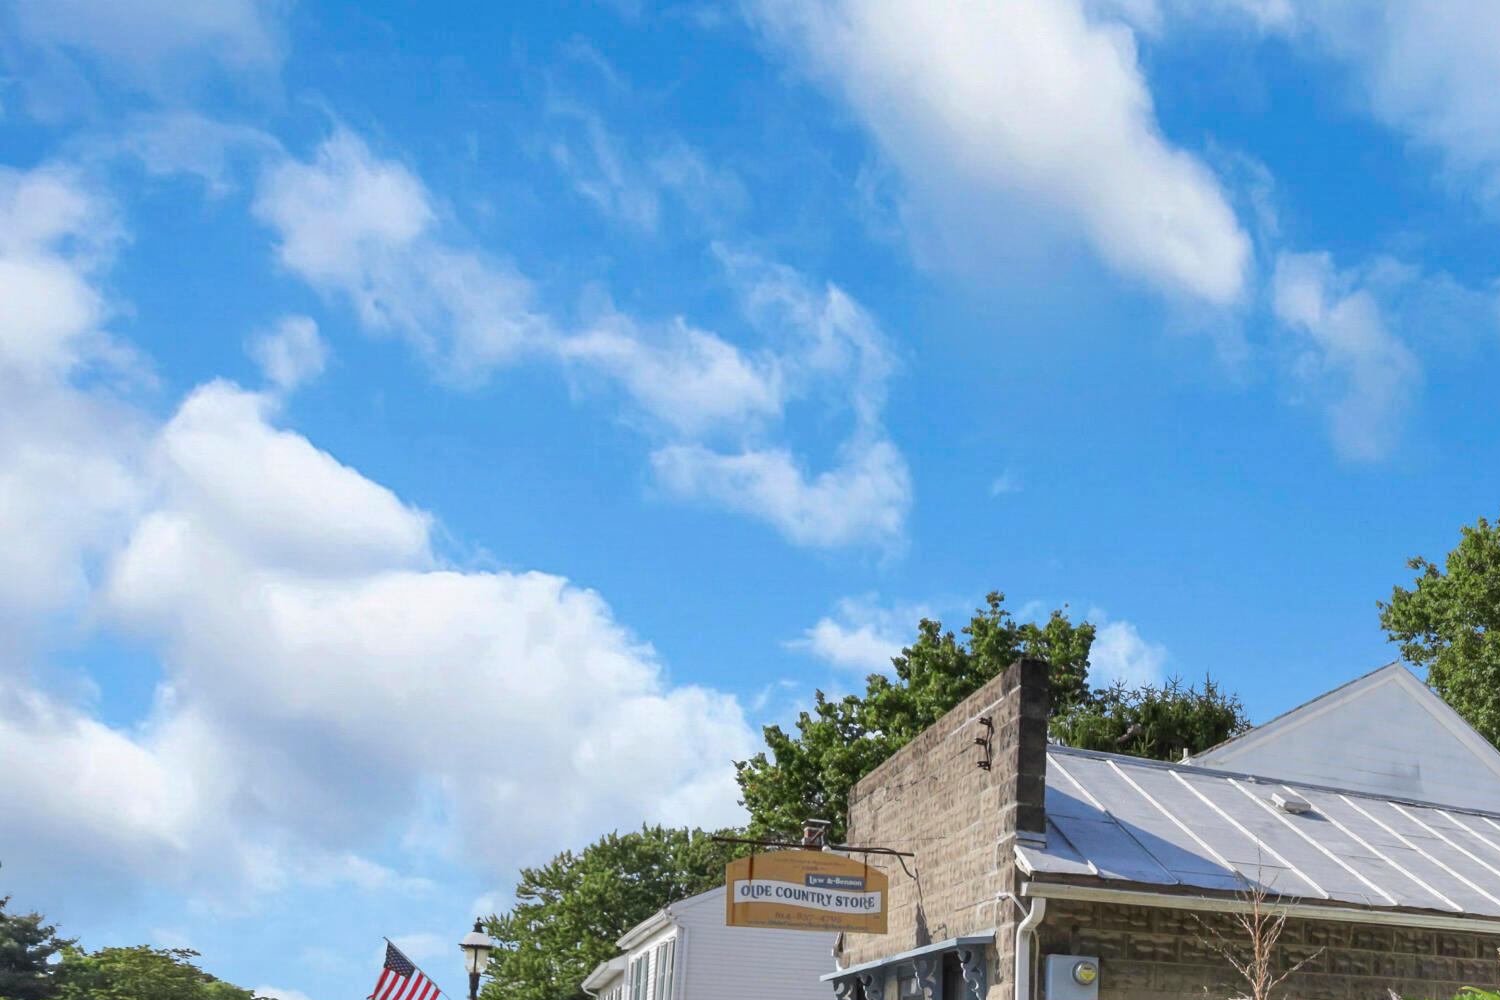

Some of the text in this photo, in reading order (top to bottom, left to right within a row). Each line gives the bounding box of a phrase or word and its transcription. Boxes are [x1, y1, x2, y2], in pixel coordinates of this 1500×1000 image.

[741, 885, 875, 910] OLDE COUNTRY STORE
